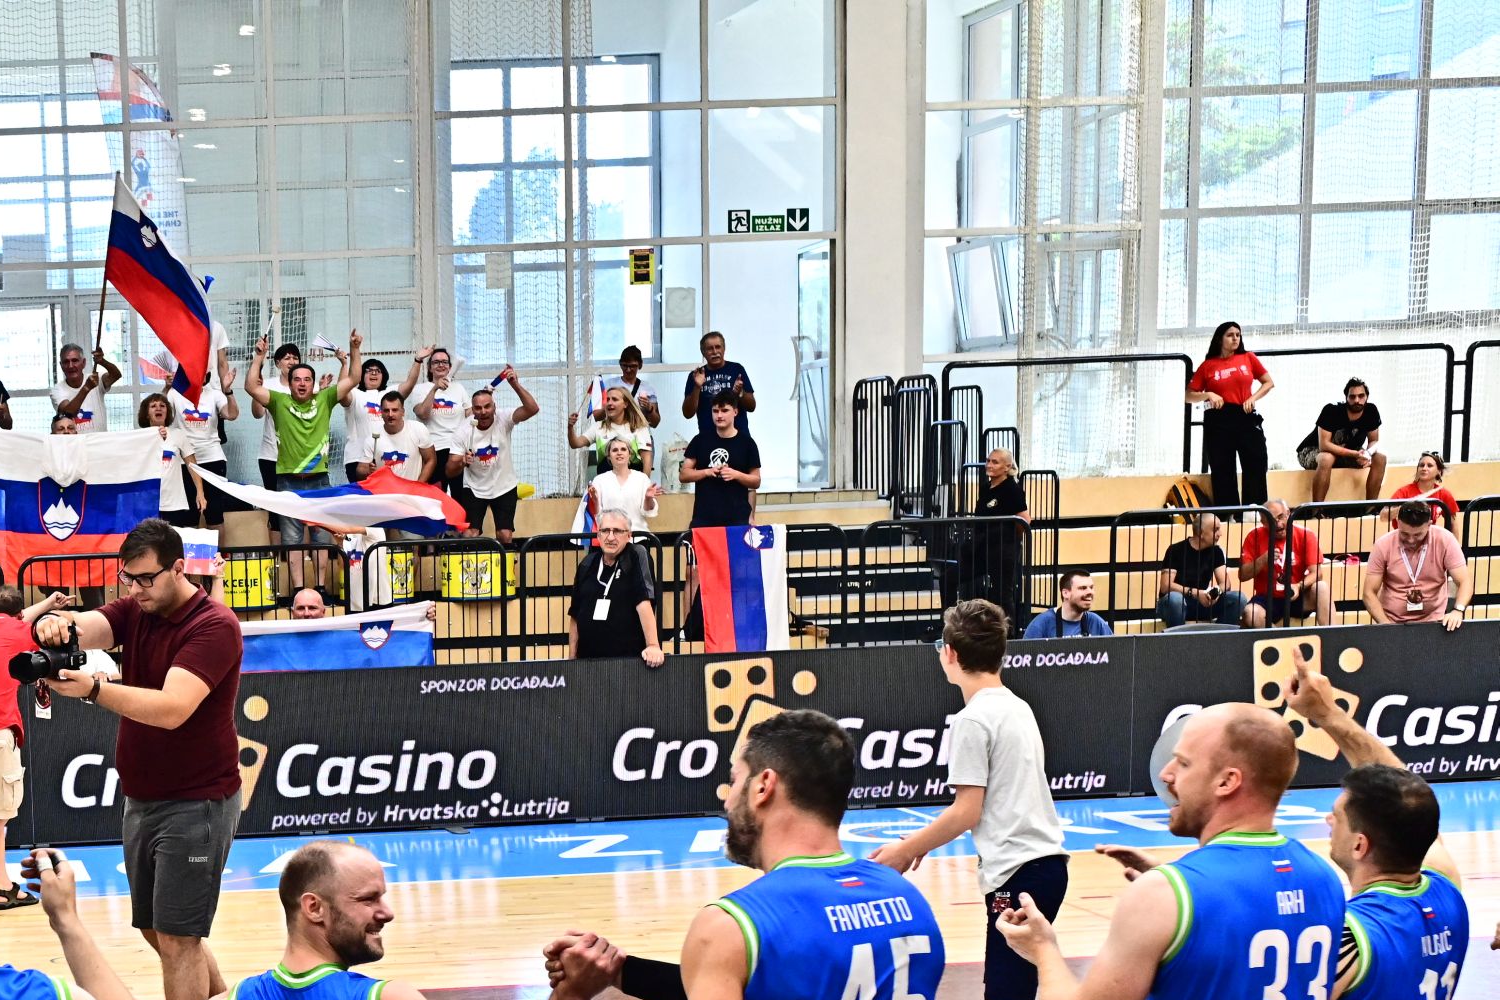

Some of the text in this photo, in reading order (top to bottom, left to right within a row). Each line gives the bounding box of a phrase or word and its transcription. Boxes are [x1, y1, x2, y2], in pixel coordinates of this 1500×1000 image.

[1036, 652, 1108, 666] DOGAĐAJA
[421, 676, 565, 693] SPONZOR DOGAĐAJA
[1366, 692, 1500, 748] Casi
[612, 727, 719, 782] Cro
[61, 740, 496, 808] Cr Casino
[1439, 757, 1460, 779] by
[898, 781, 918, 798] by
[1051, 772, 1106, 791] utrija
[272, 798, 569, 829] powered by Hrvatska Lutrija
[825, 897, 913, 932] FAVRETTO
